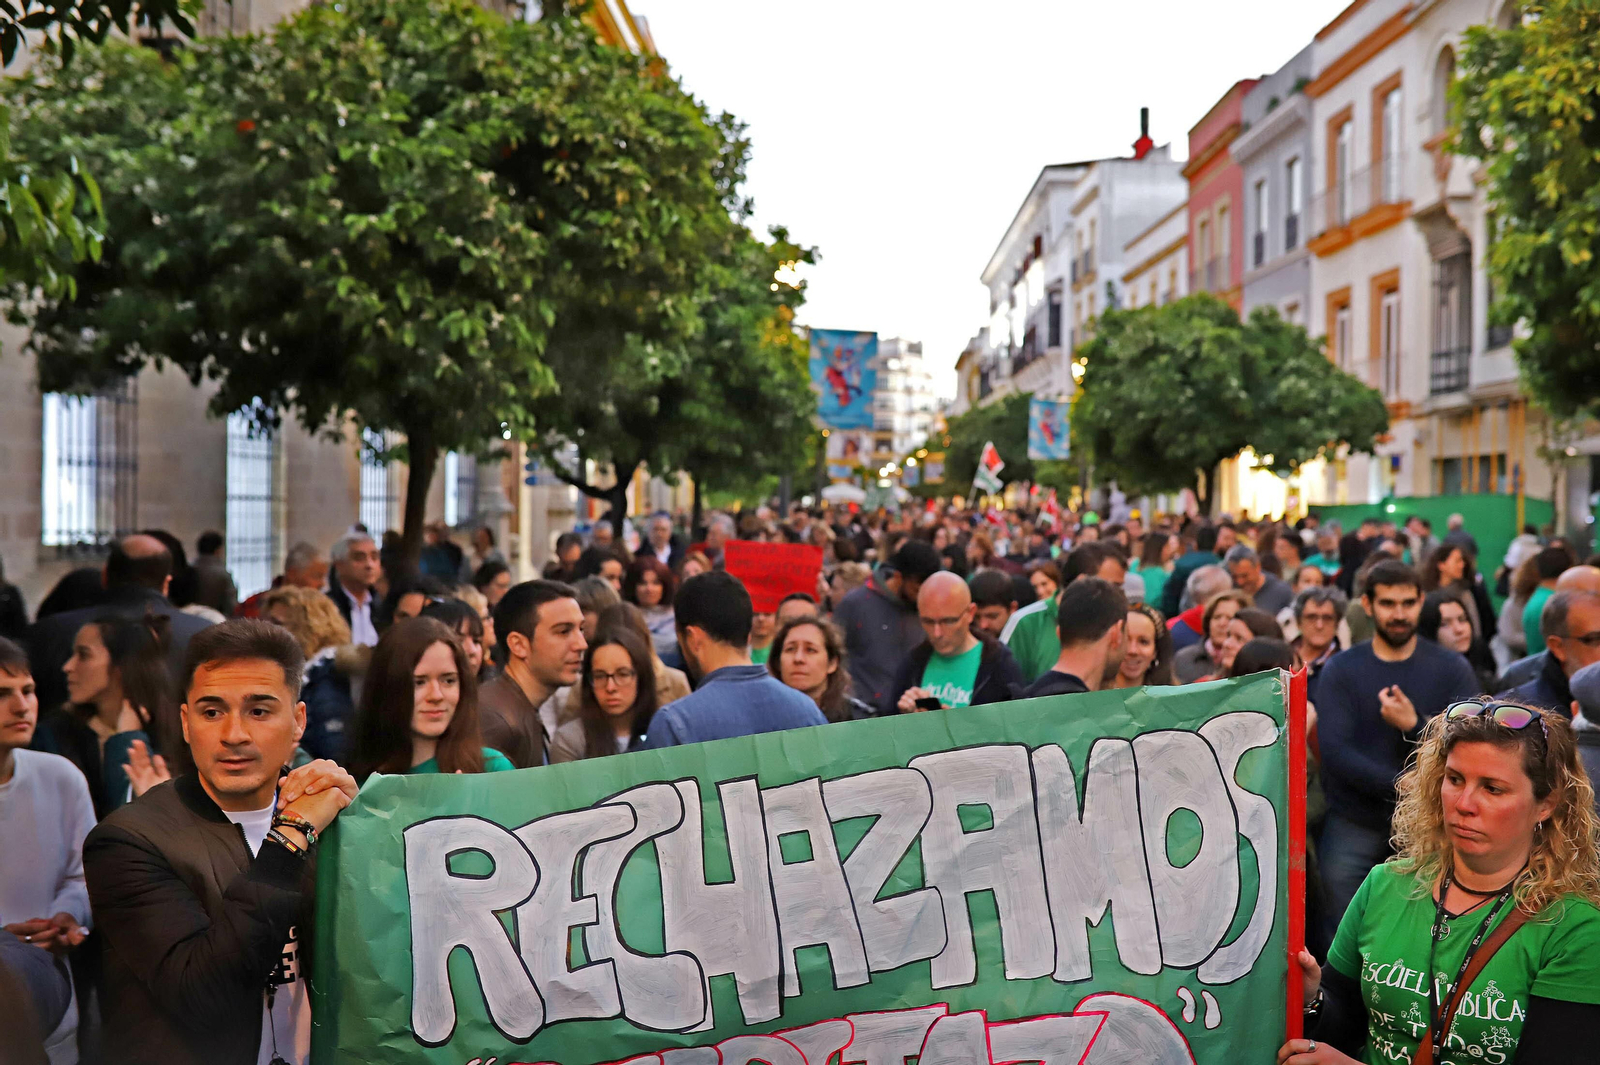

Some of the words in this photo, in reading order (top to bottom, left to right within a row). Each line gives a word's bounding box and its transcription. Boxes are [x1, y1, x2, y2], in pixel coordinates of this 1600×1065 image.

[403, 711, 1278, 1046] RECHAZAMOS
[1361, 959, 1440, 1006] ESCUEL
[1406, 1019, 1507, 1065] TD@S
